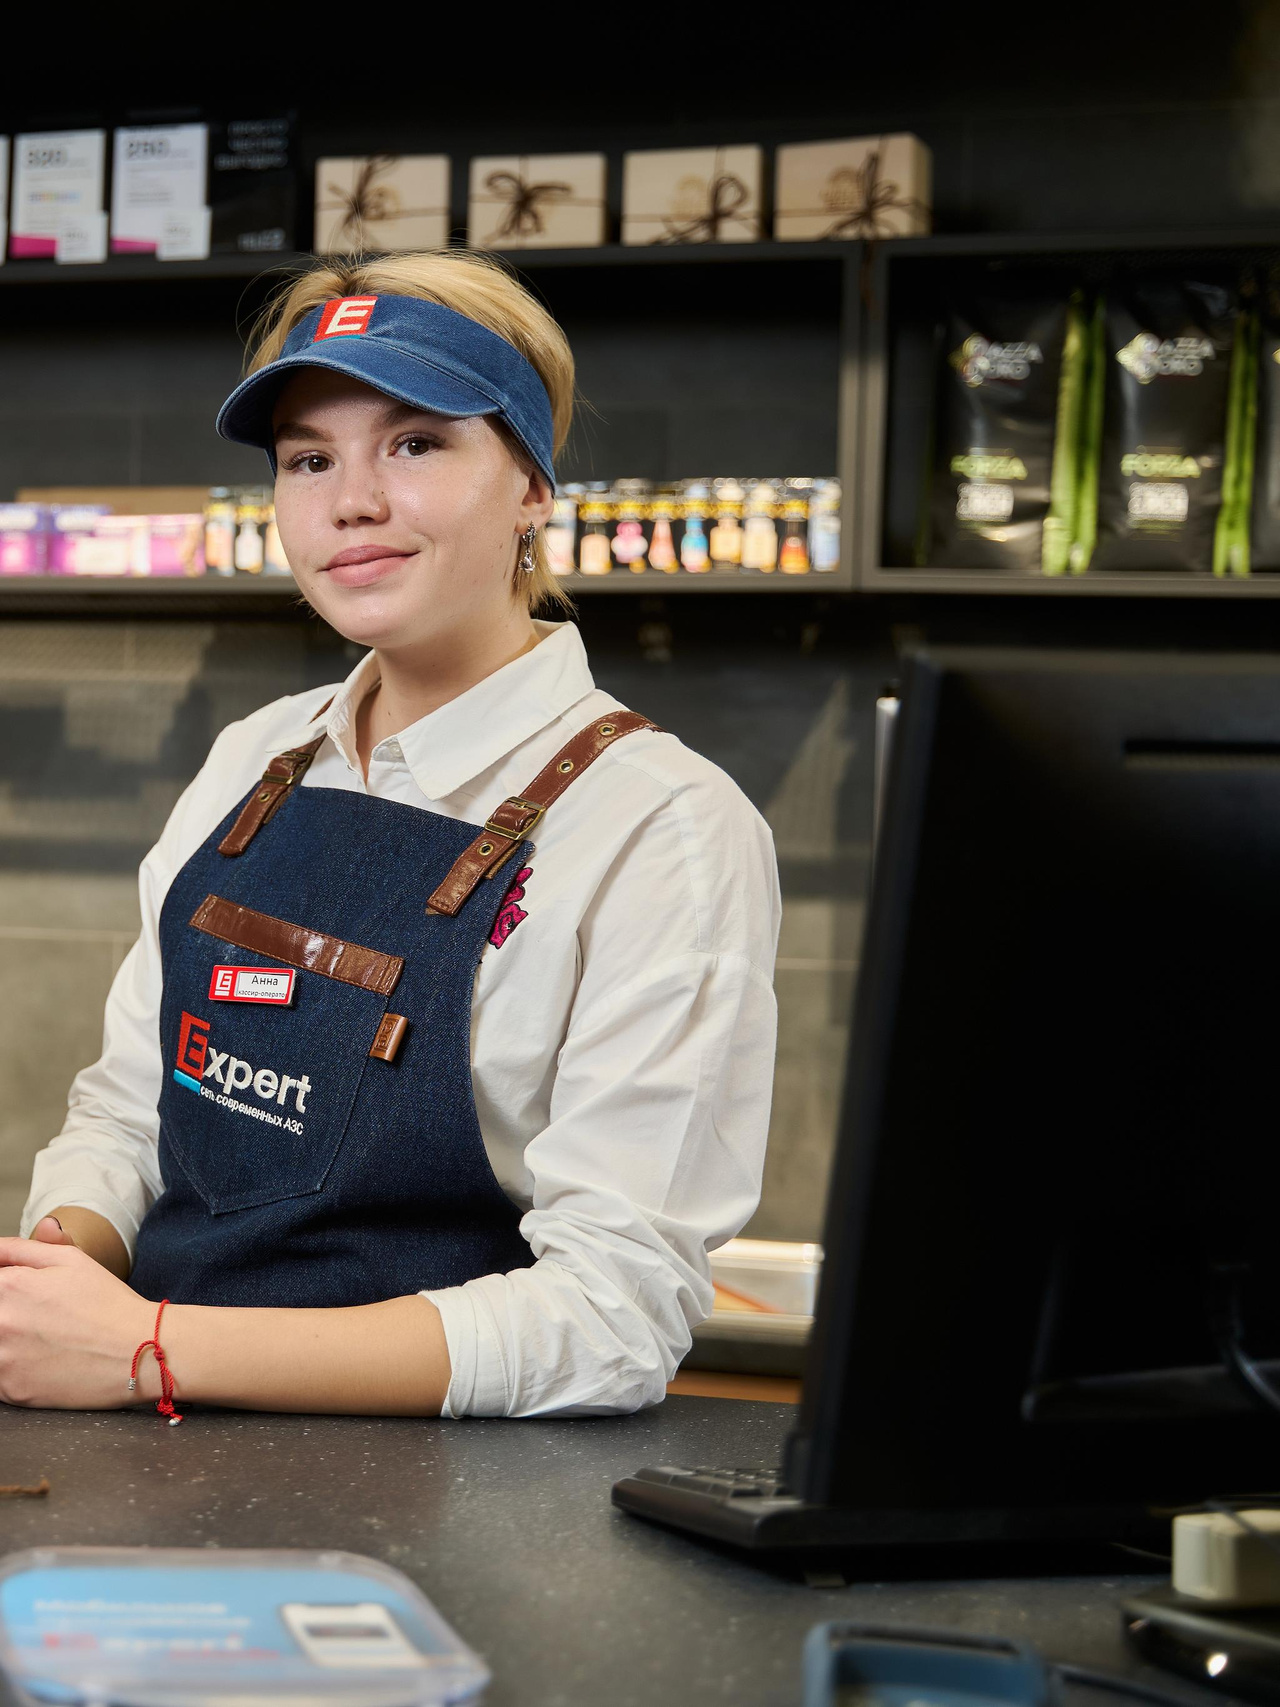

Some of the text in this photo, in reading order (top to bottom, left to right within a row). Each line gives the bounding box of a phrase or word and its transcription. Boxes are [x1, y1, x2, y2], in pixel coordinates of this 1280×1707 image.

[325, 298, 377, 336] E
[238, 989, 287, 998] кассир-операто
[251, 974, 279, 986] Анна
[176, 1010, 312, 1114] Expert
[200, 1085, 304, 1135] сеть современных АЗС
